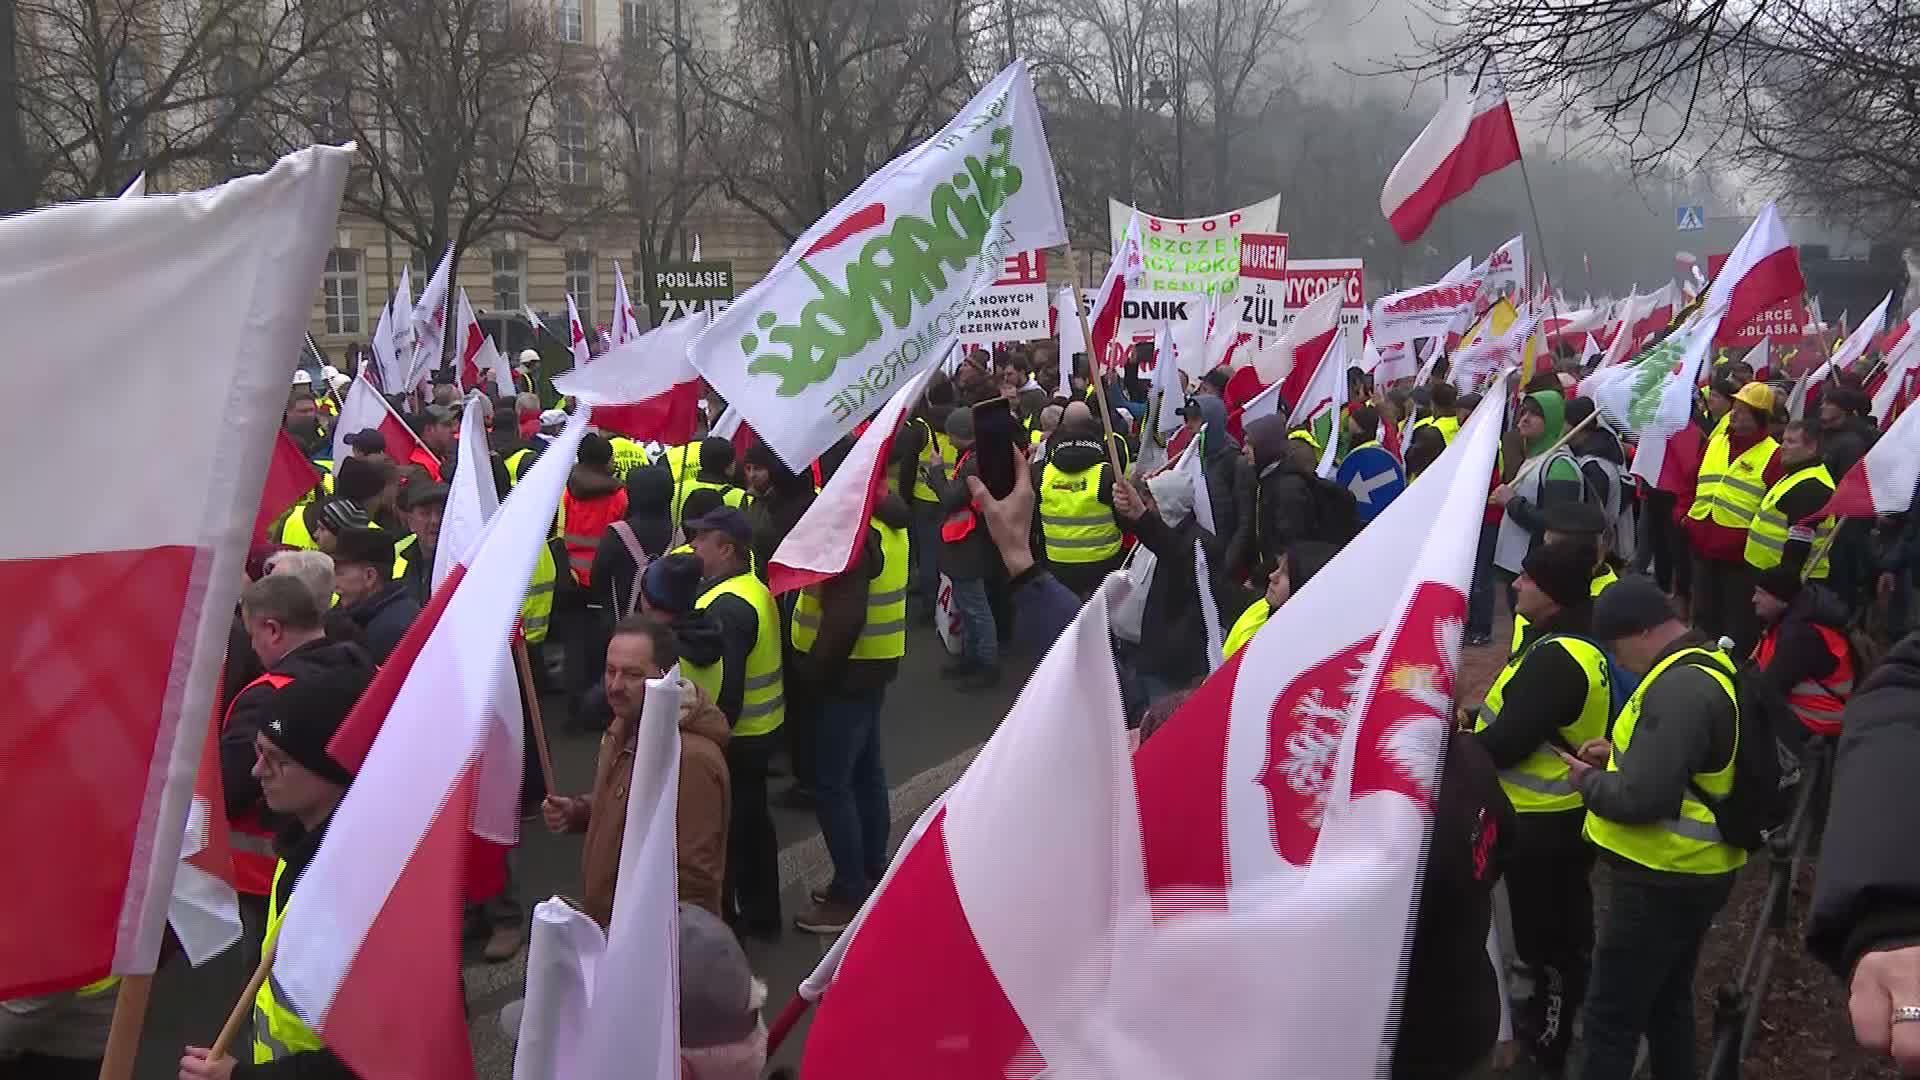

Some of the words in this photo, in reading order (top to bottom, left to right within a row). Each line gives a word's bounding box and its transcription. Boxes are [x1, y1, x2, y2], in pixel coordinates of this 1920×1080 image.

[1150, 214, 1241, 233] STOP
[1186, 257, 1240, 274] POKO
[1242, 244, 1286, 271] MUREM
[656, 271, 728, 288] PODLASIE
[980, 293, 1034, 305] NOWYCH
[1076, 294, 1189, 321] ŚDNIK
[1242, 295, 1278, 327] ZUL
[1749, 308, 1793, 322] ERCE
[960, 319, 1039, 334] EZERWATÓW
[1737, 322, 1799, 337] ODLASIA
